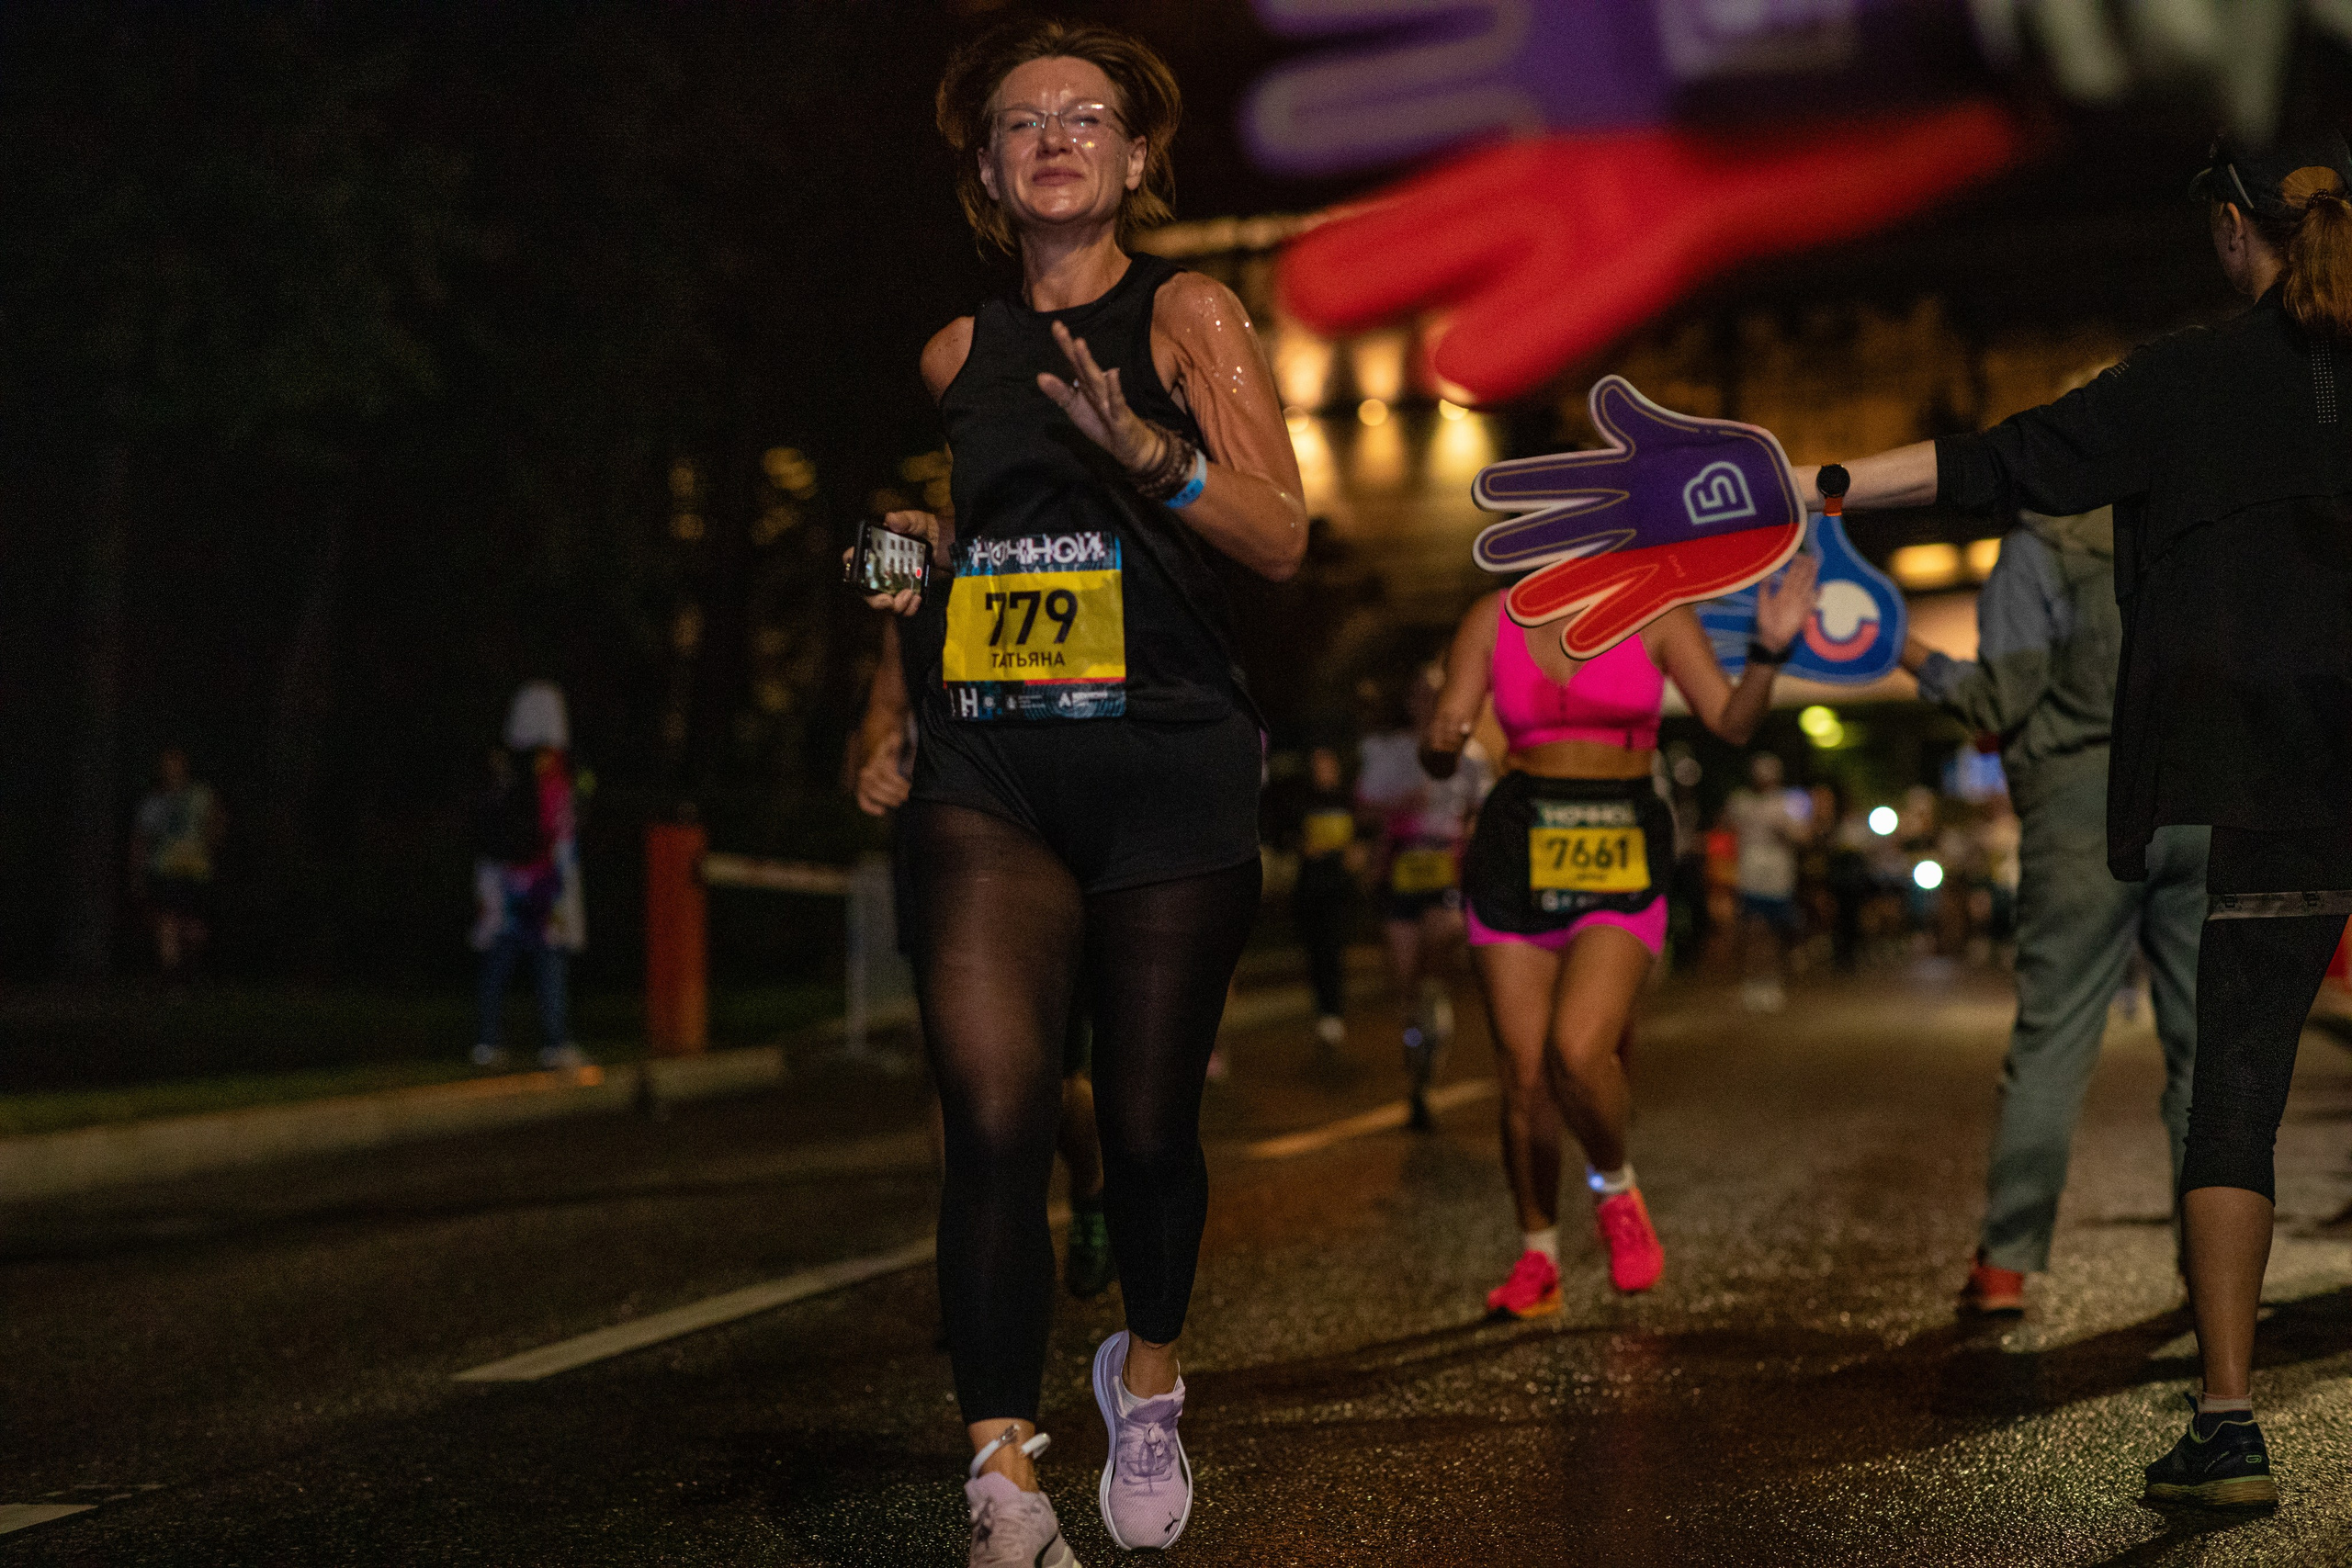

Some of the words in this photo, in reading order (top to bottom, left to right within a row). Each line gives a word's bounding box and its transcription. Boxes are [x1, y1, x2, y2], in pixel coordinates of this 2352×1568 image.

[985, 589, 1078, 647] 779
[990, 651, 1066, 668] ТАТЬЯНА
[1545, 835, 1628, 870] 7661
